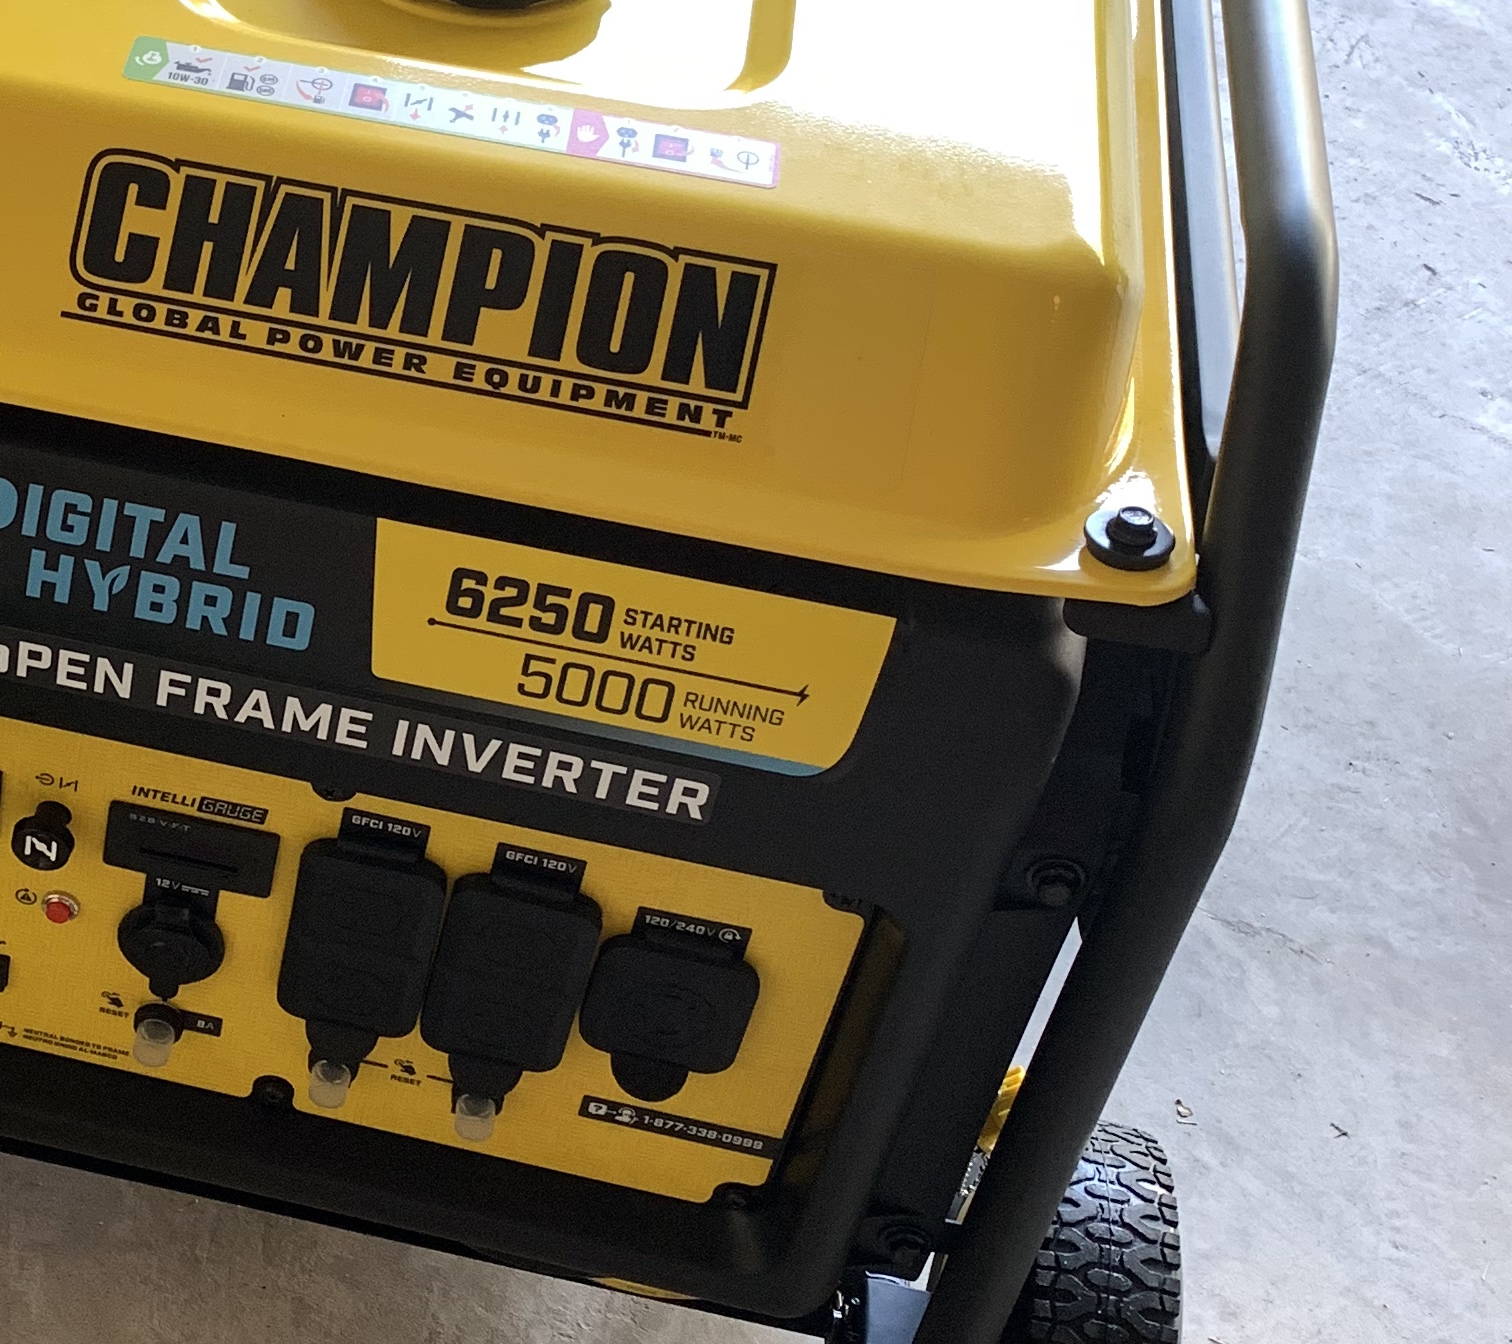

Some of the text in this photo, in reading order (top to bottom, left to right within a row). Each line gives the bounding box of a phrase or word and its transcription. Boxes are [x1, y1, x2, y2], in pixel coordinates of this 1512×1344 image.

[168, 72, 208, 85] 10W-30
[81, 157, 763, 395] CHAMPION
[77, 292, 734, 429] GLOBAL POWER EQUIPMENT
[25, 548, 316, 651] HYBRID
[445, 567, 735, 646] 6250 STARTING
[619, 631, 697, 662] WATTS
[517, 653, 785, 726] 5000 RUNNING
[679, 712, 756, 743] WATTS
[156, 669, 370, 750] FRAME
[392, 719, 711, 820] INVERTER
[132, 785, 265, 823] INTELLI GAUGE
[351, 814, 422, 838] GFCI 120V
[505, 850, 578, 873] GFCI 120V
[645, 914, 715, 937] 120/240V
[99, 1007, 129, 1019] RESET
[24, 1028, 59, 1042] NEUTRAL
[102, 1045, 130, 1056] FRAME
[390, 1074, 421, 1086] RESET
